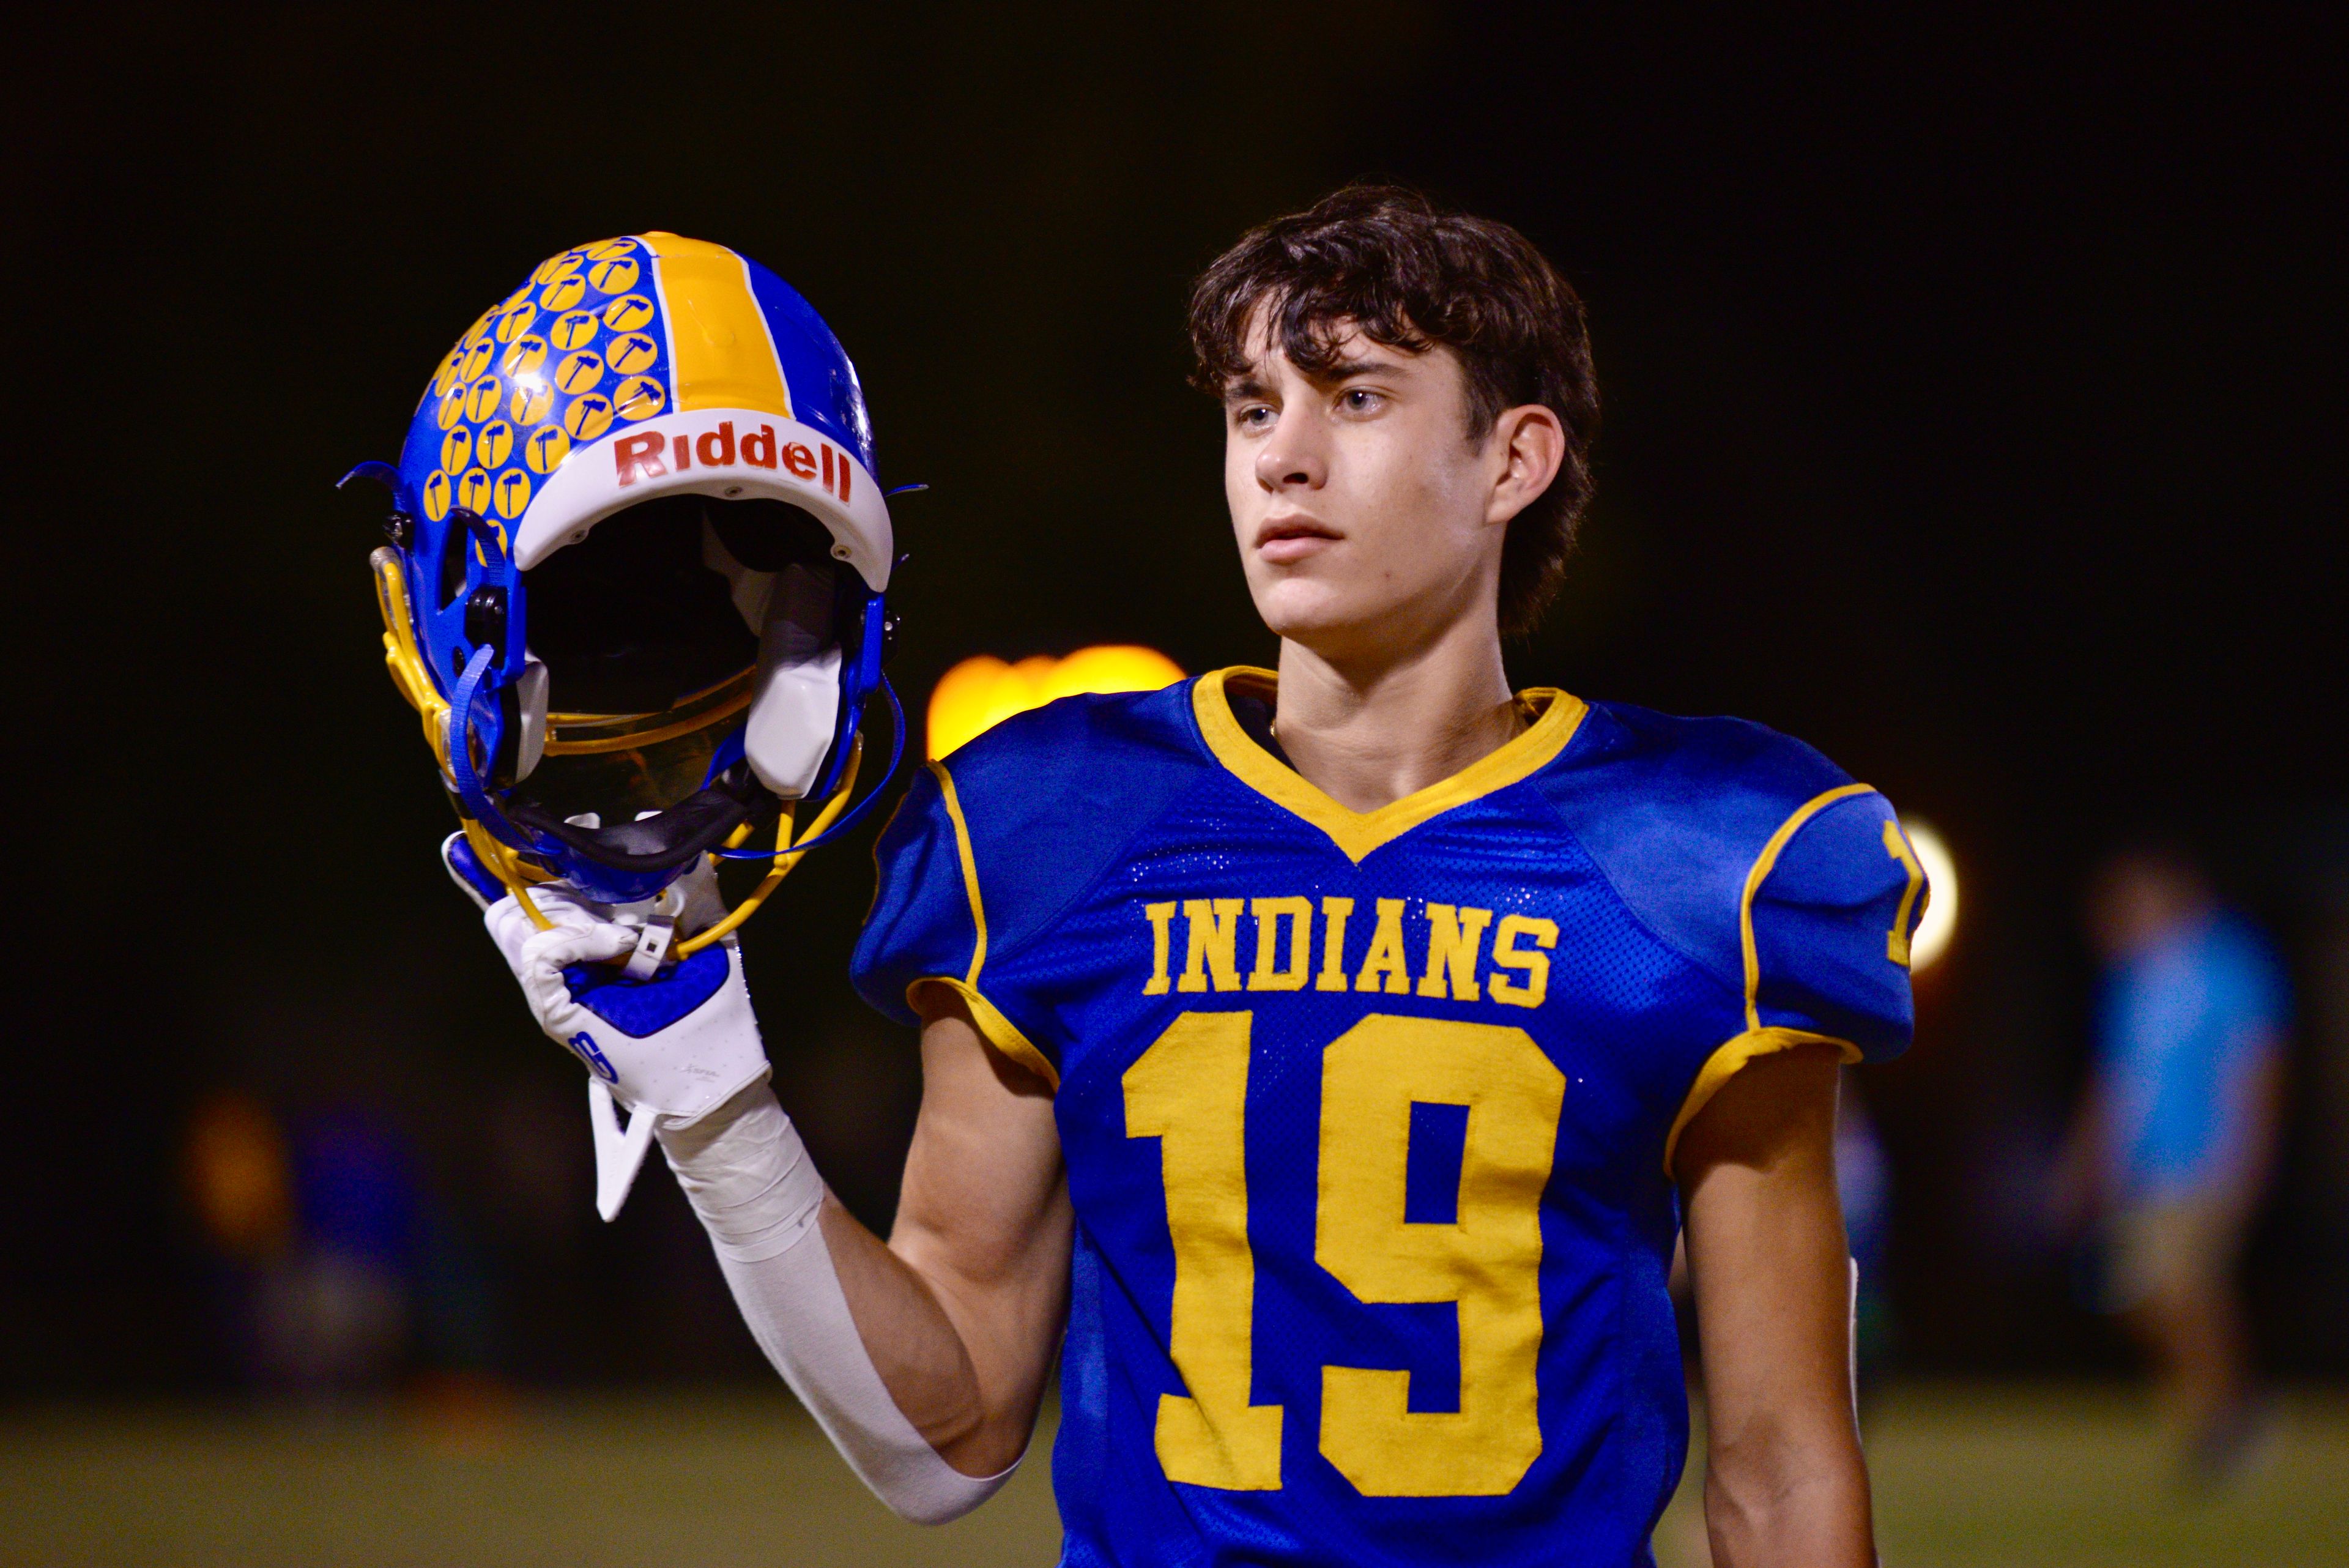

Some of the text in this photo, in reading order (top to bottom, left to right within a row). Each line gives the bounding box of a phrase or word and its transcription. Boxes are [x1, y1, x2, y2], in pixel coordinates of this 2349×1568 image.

[614, 421, 851, 506] Riddell
[1143, 896, 1559, 1008] INDIANS
[1121, 1010, 1567, 1497] 19
